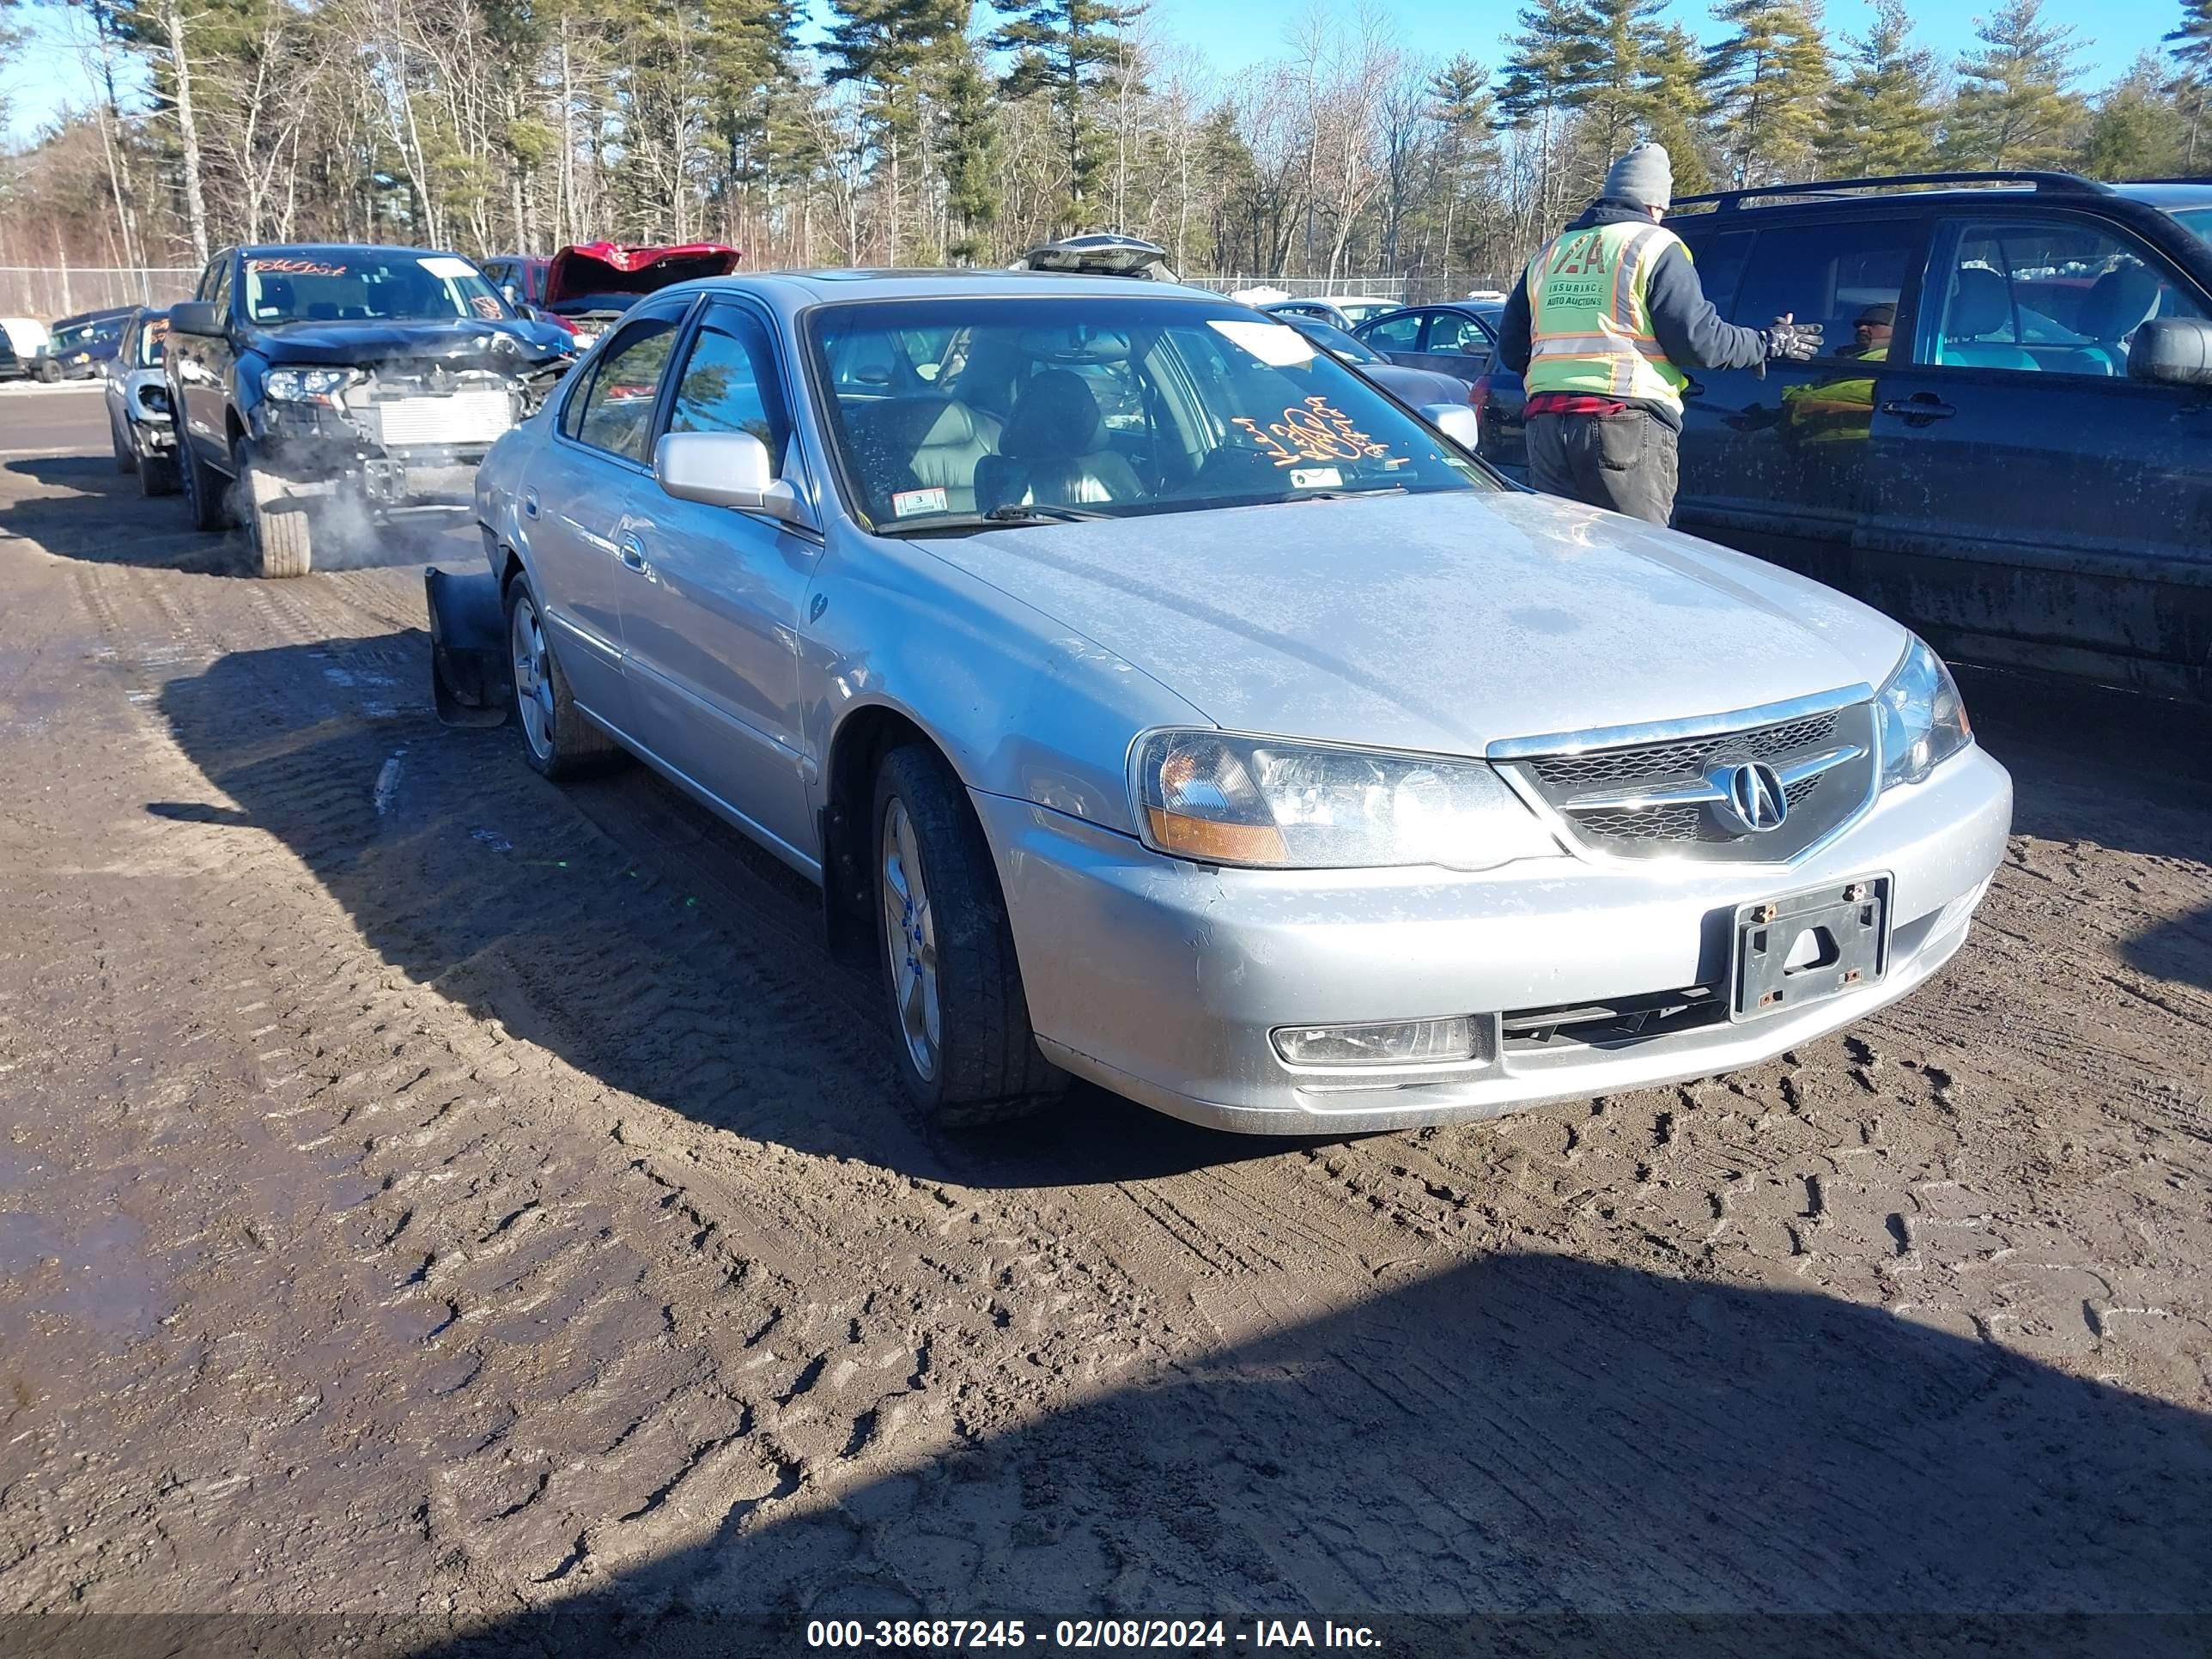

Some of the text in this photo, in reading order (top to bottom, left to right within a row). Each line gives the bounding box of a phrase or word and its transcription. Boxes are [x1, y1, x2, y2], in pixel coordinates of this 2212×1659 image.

[1548, 283, 1605, 294] INSURANCE
[1547, 296, 1603, 307] AUTO AUCTIONS
